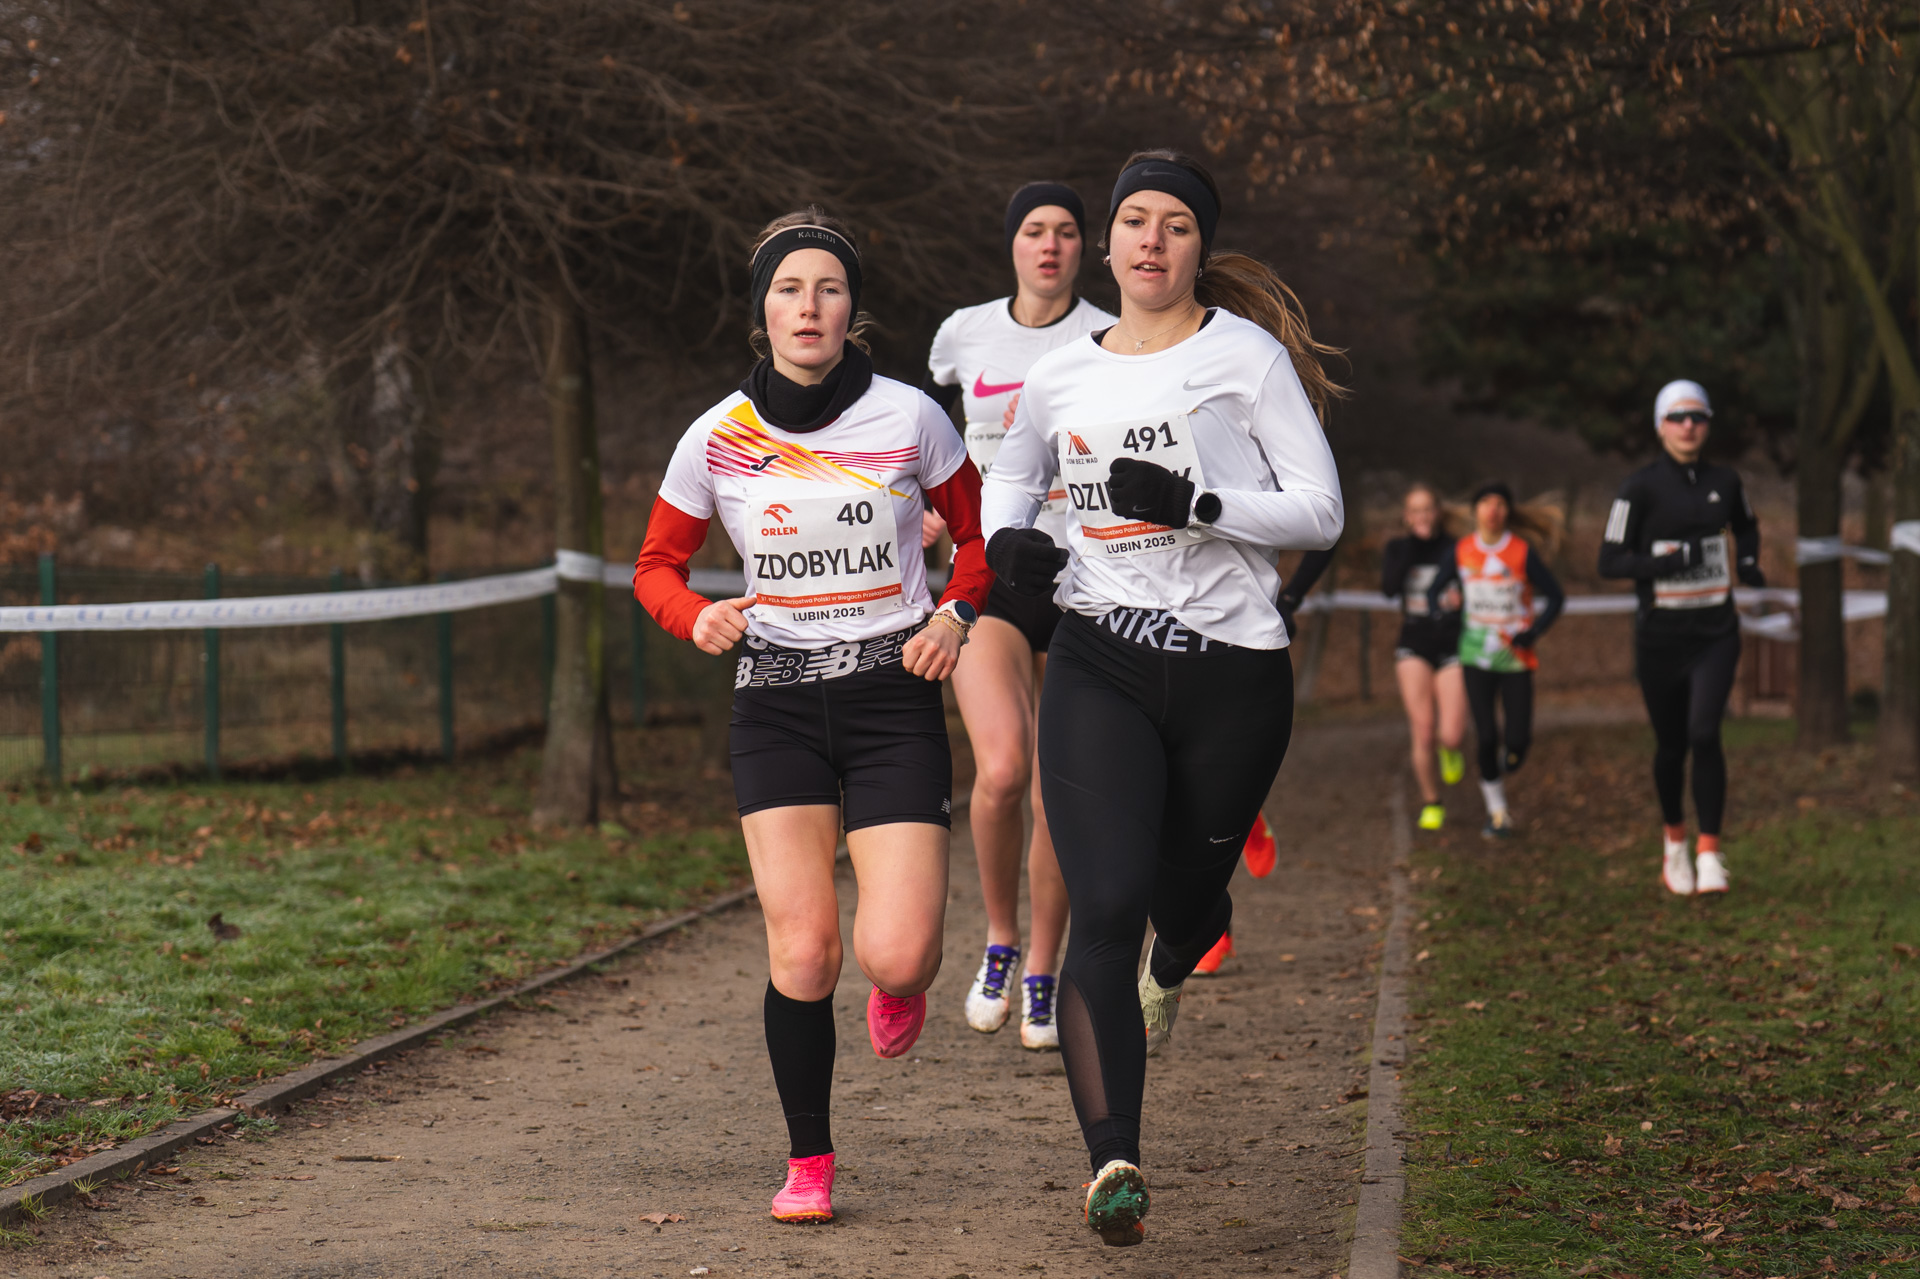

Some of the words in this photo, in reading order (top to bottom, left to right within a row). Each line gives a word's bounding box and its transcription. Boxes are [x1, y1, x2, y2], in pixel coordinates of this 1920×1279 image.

[797, 231, 836, 244] KALENJI
[1122, 421, 1178, 453] 491
[1085, 456, 1099, 464] WAD
[836, 501, 873, 526] 40
[761, 526, 798, 536] ORLEN
[1124, 525, 1140, 533] Polski
[1105, 540, 1142, 554] LUBIN
[1144, 535, 1176, 549] 2025
[753, 542, 894, 581] ZDOBYLAK
[813, 595, 830, 603] Polski
[838, 593, 862, 602] Biegach
[792, 609, 830, 622] LUBIN
[833, 606, 865, 618] 2025
[1095, 607, 1190, 653] NIKE
